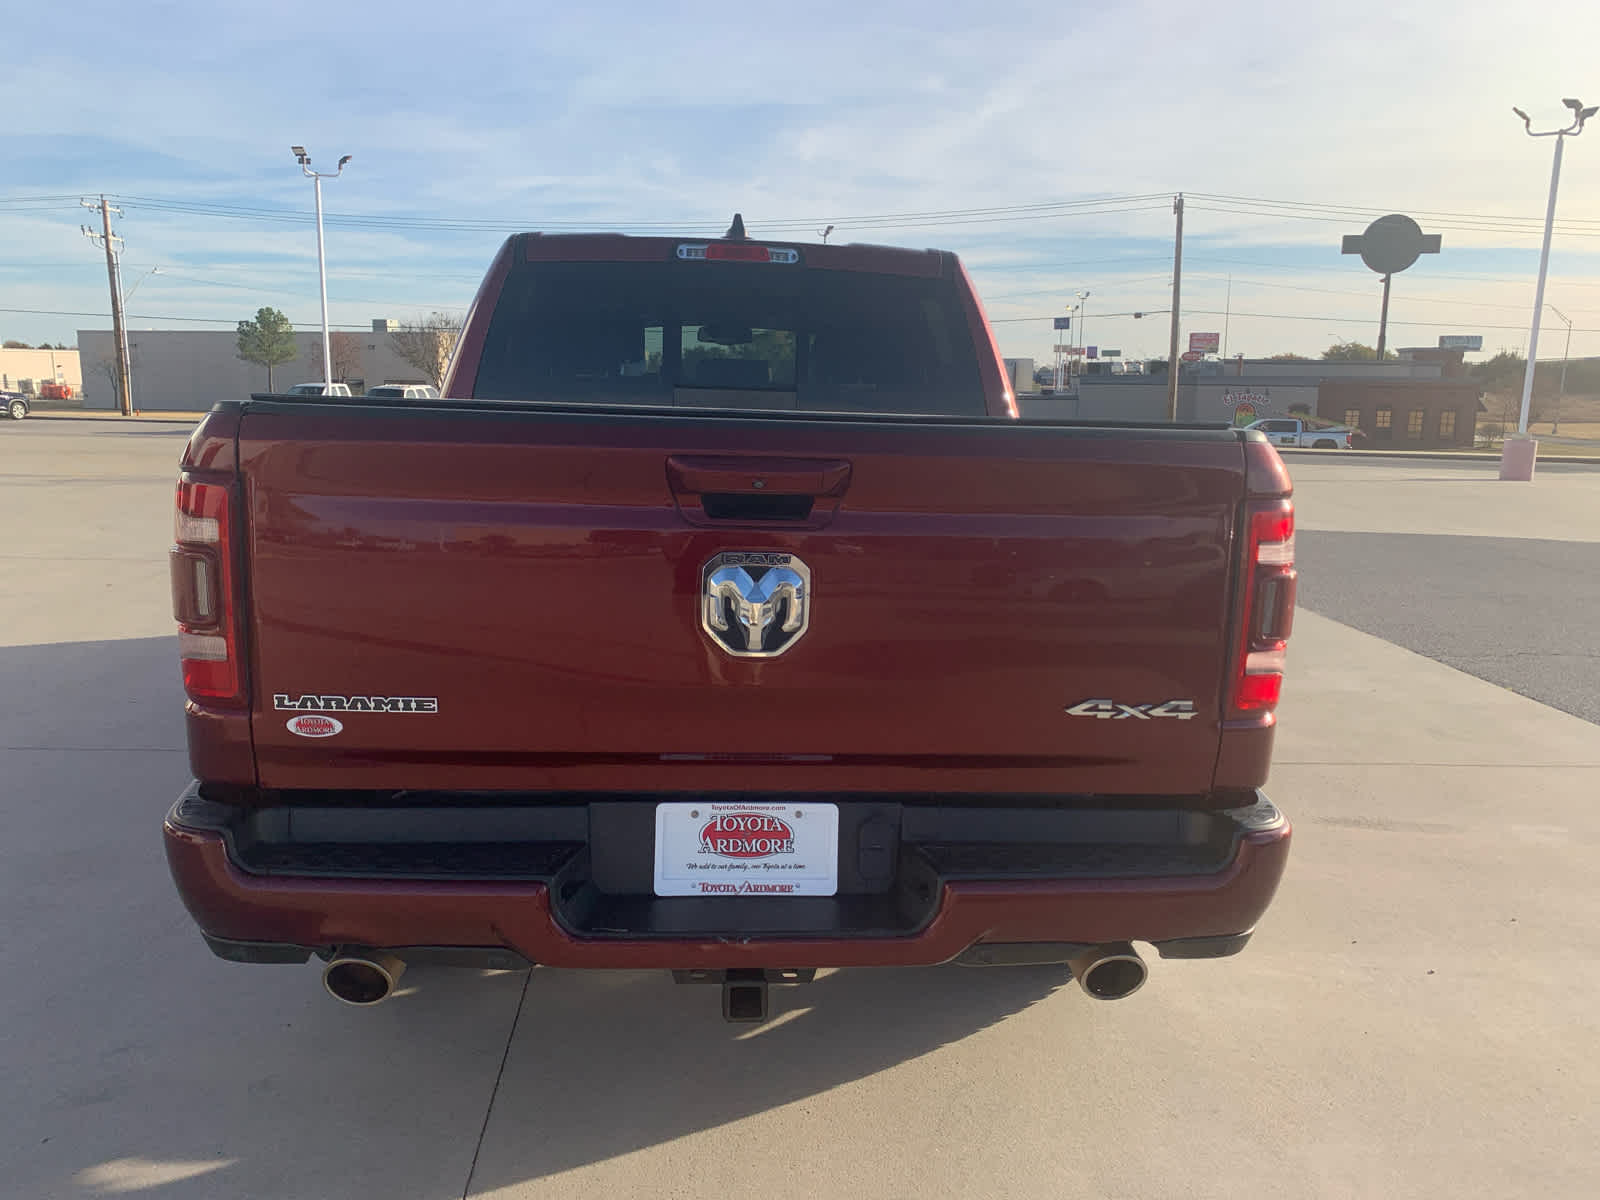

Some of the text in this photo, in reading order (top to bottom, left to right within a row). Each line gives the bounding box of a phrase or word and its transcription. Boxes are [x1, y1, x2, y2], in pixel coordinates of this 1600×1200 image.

[720, 554, 791, 565] RAM
[273, 694, 438, 713] LARAMIE
[1064, 699, 1199, 720] 4x4
[710, 814, 784, 832] TOYOTA
[698, 835, 794, 853] ARDMORE
[698, 882, 737, 893] TOYOTA
[744, 880, 794, 893] ARDMORE
